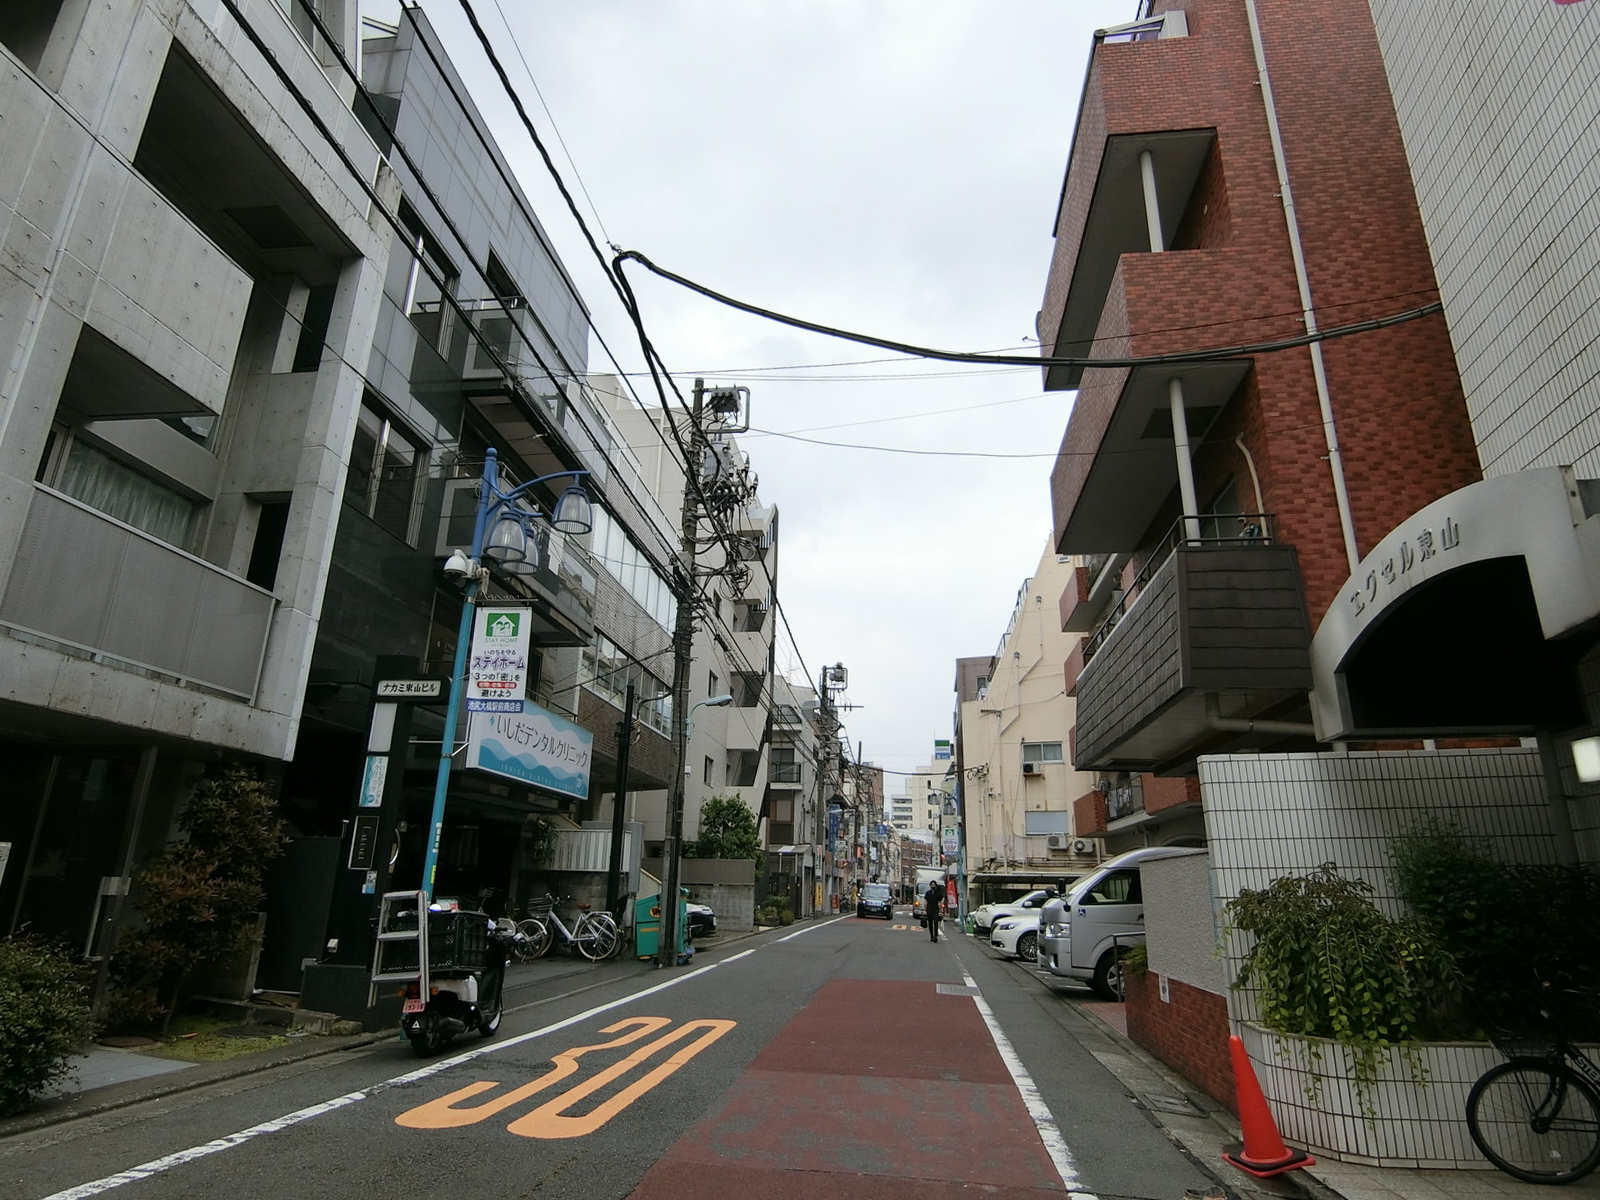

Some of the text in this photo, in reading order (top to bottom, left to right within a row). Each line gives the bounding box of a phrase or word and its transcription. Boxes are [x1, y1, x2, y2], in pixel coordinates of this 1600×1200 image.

[1350, 516, 1460, 618] エクセル東山
[473, 656, 525, 669] ステイホーム
[382, 683, 437, 693] ナカミ東山ビル
[481, 689, 512, 698] 避けよう
[496, 714, 589, 768] いしだデンタルクリニック
[394, 1016, 738, 1139] 30
